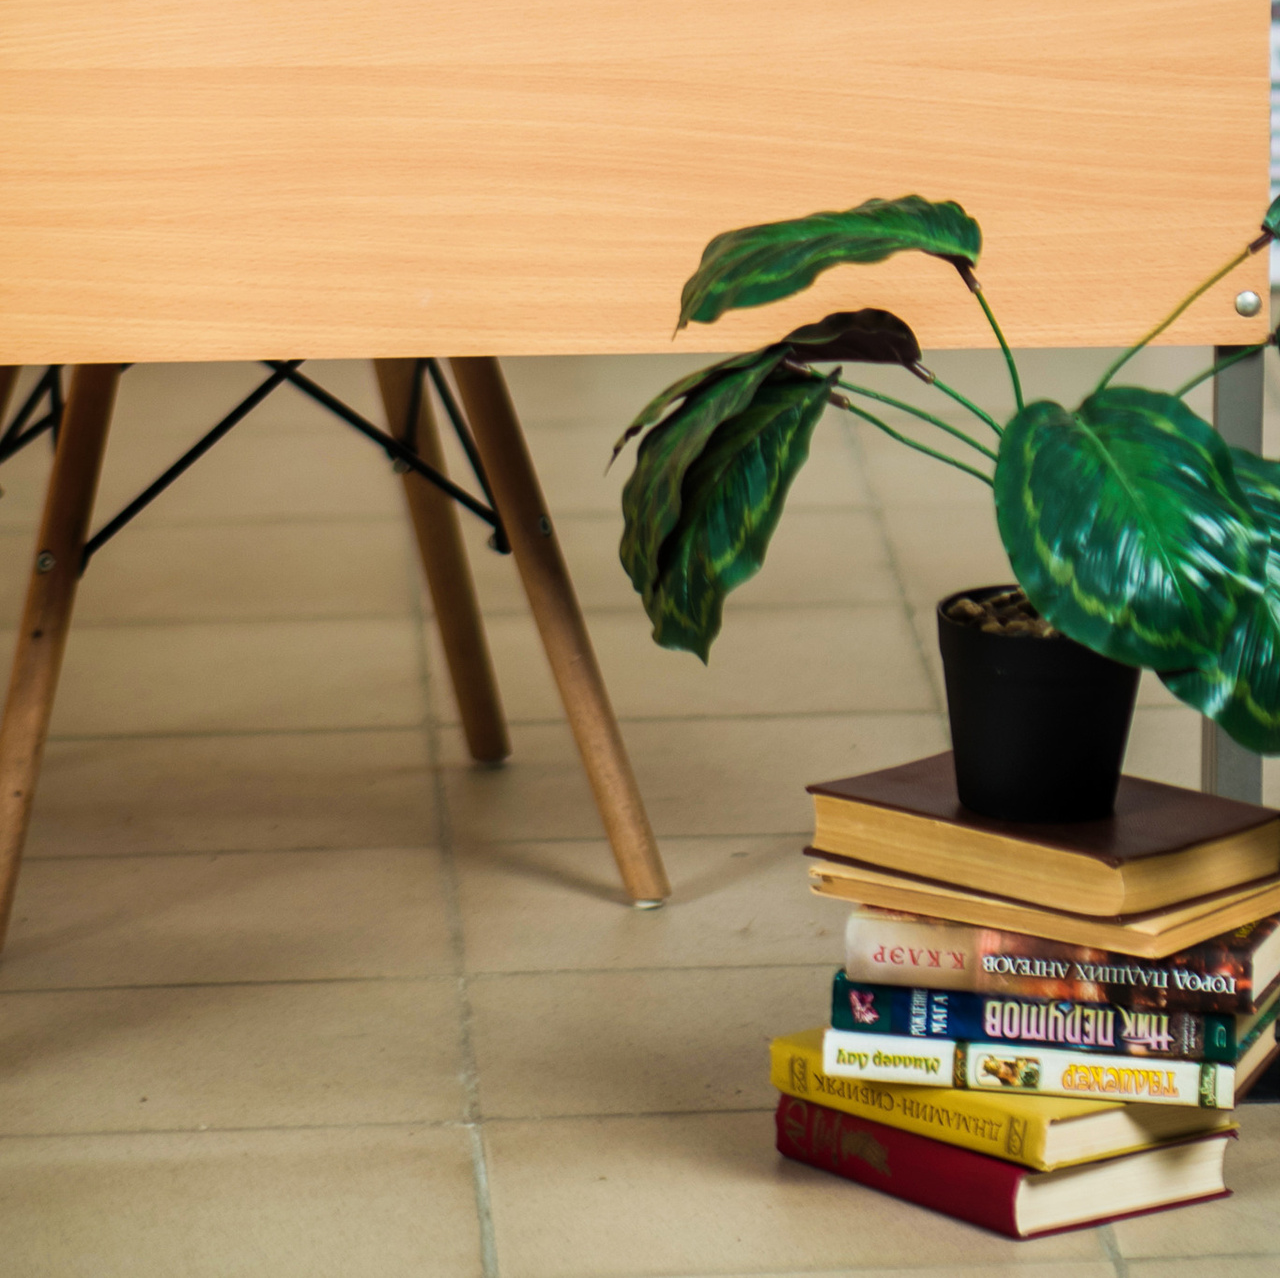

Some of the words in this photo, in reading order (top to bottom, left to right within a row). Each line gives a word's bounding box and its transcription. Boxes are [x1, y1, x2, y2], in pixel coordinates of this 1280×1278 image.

[981, 953, 1071, 979] АНГЕЛОВ
[1074, 962, 1169, 989] ПАДШИХ
[1171, 968, 1238, 995] ГОРОД
